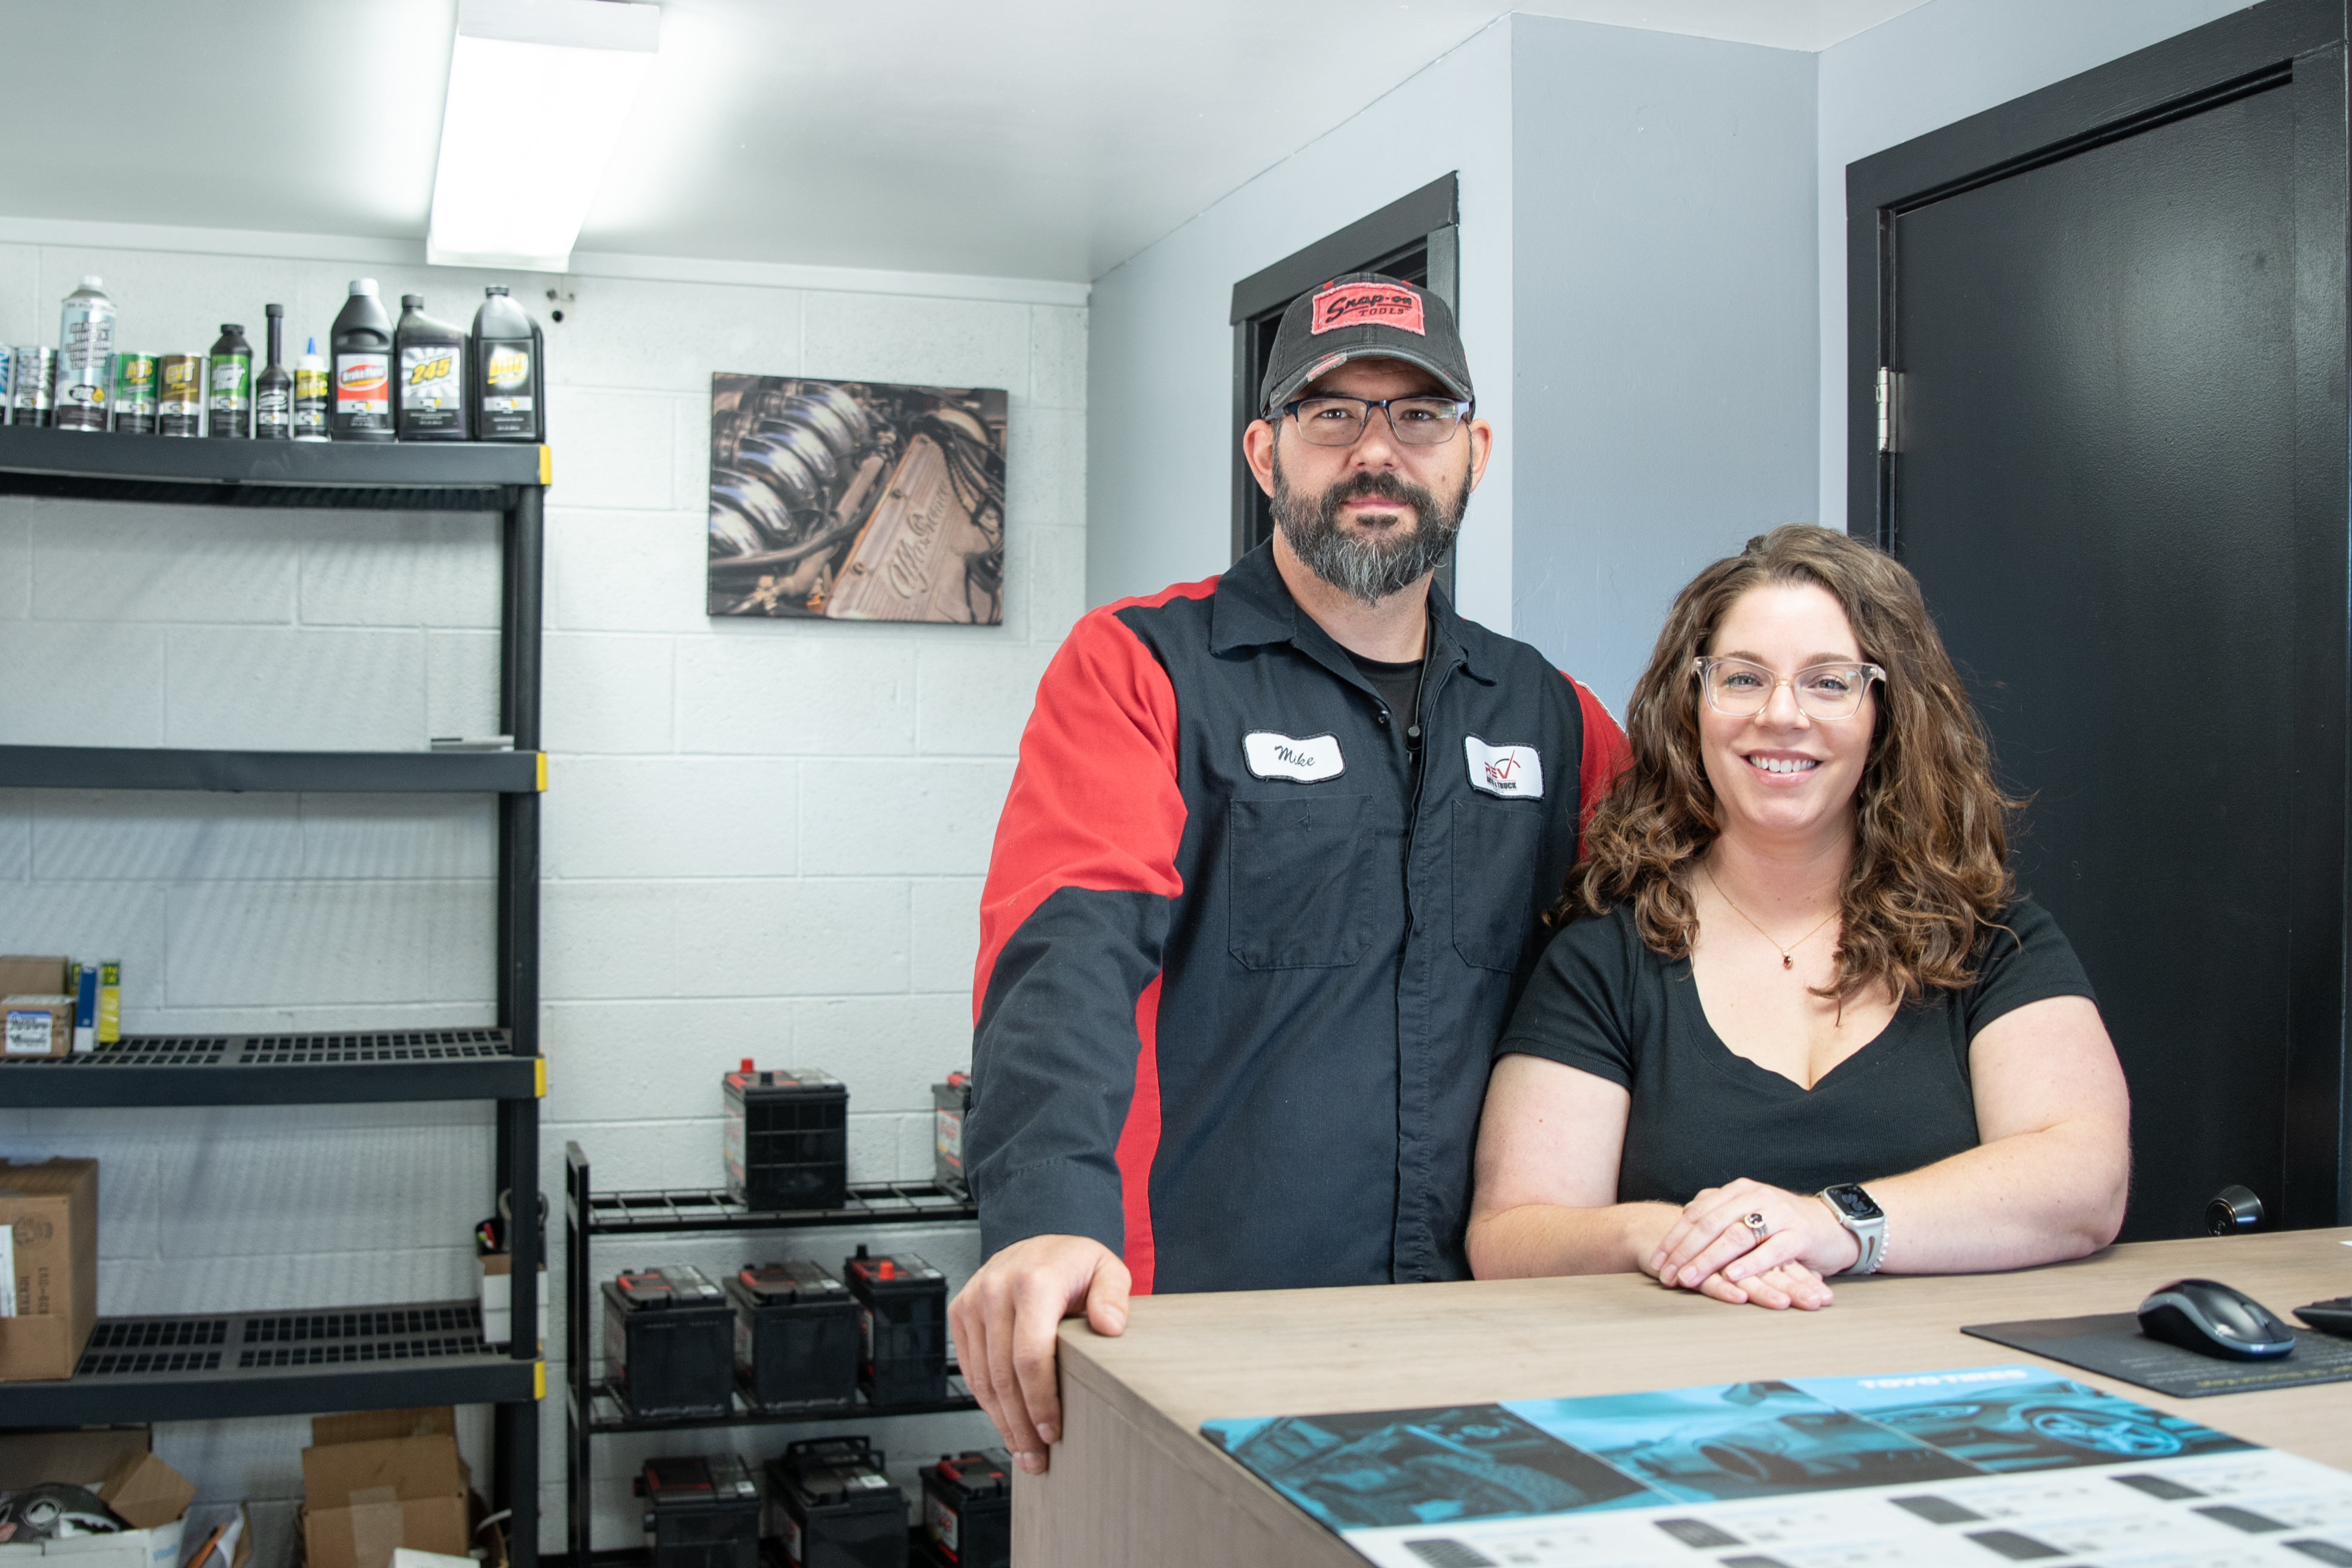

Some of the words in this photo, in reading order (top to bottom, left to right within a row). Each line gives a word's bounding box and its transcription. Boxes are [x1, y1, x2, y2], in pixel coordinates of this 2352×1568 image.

[1325, 295, 1412, 323] Snap-on
[1359, 307, 1404, 317] TOOLS
[125, 360, 153, 379] ATC
[165, 362, 195, 384] CVT
[342, 369, 366, 382] Brake
[410, 357, 451, 384] 245
[1275, 745, 1315, 767] Mike
[1484, 749, 1515, 779] REV
[1497, 781, 1517, 789] TRUCK
